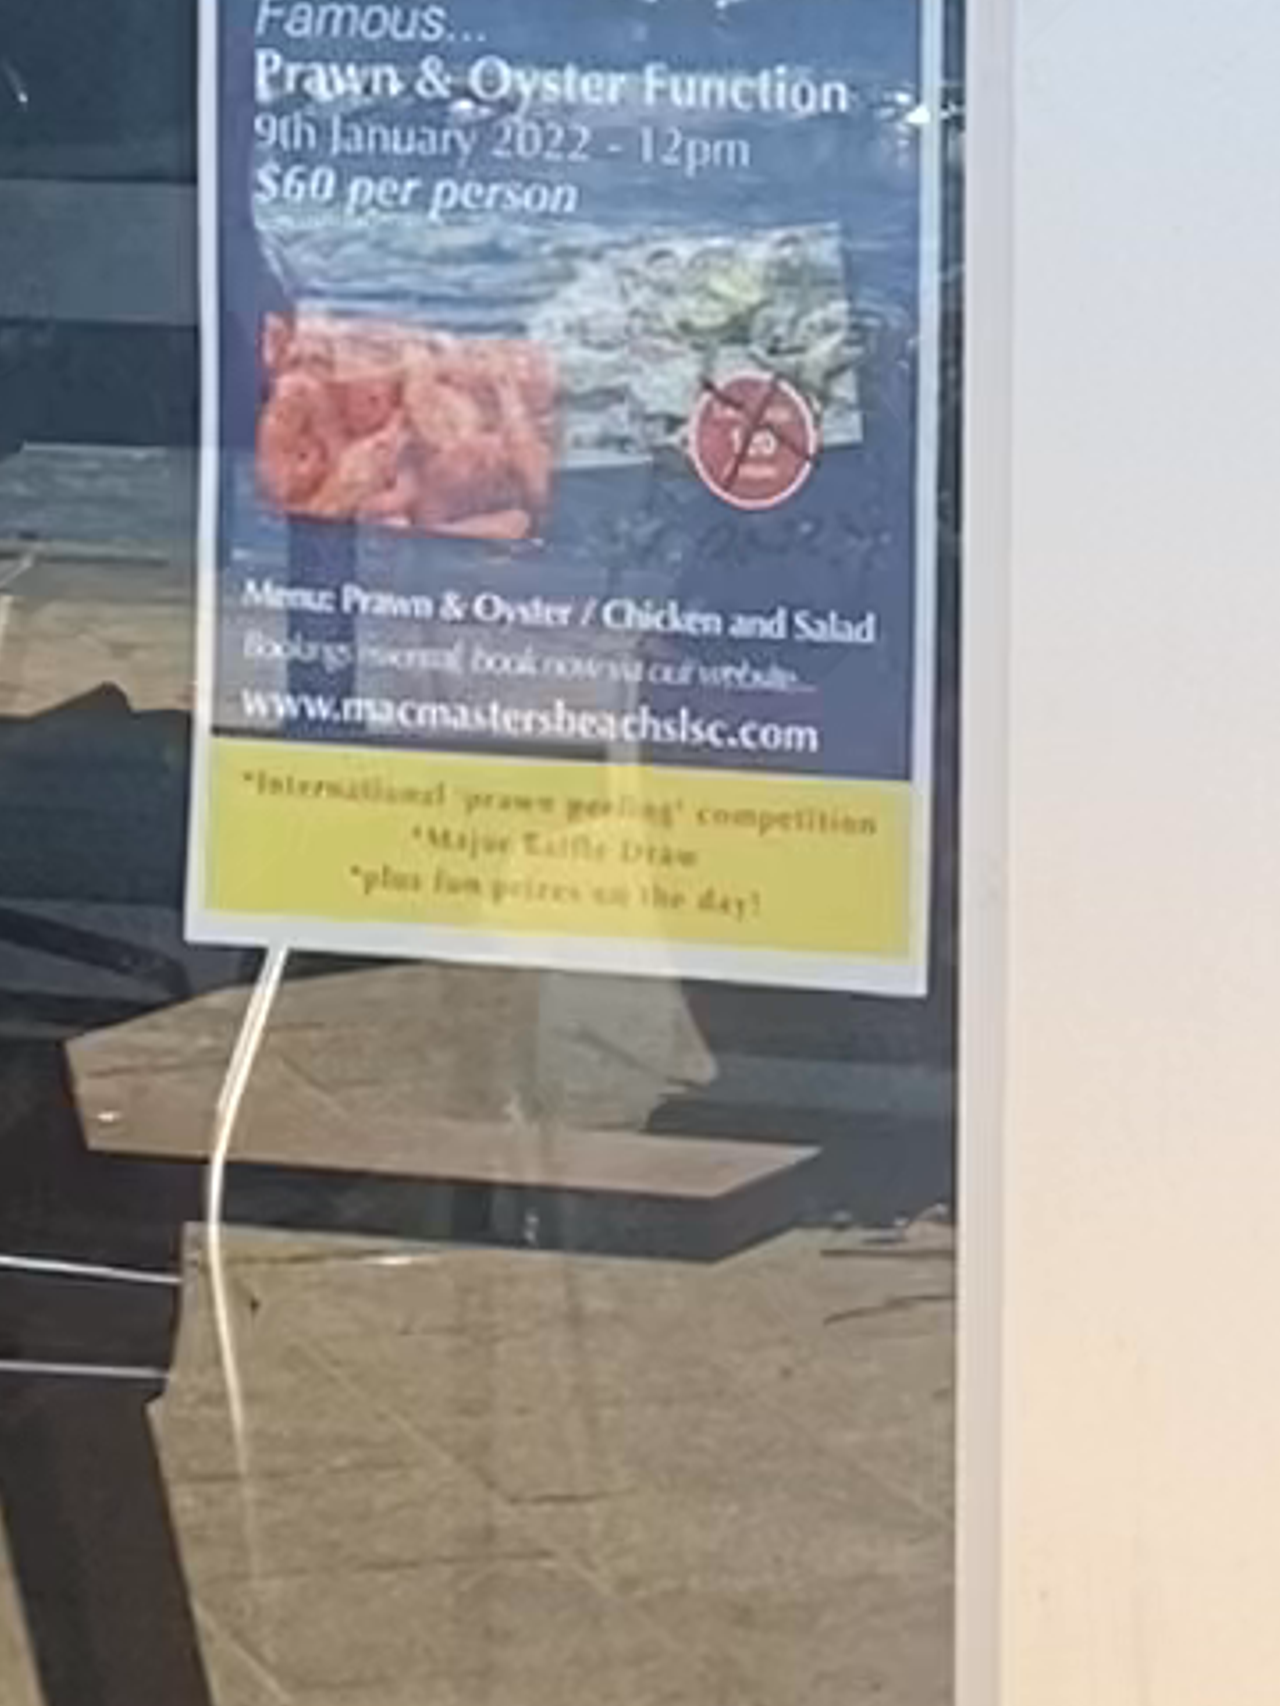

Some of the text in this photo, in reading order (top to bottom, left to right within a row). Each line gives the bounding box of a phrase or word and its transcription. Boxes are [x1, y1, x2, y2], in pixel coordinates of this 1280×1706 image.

[253, 47, 849, 117] Prawn & Oyster Function
[253, 112, 317, 151] 9th
[331, 113, 477, 168] January
[491, 120, 591, 163] 2022
[640, 126, 751, 178] 12pm
[253, 159, 579, 221] $60 per person
[340, 583, 433, 619] Prawn
[439, 590, 467, 622] &
[473, 592, 572, 629] Oyster
[601, 597, 721, 635] Chicken
[727, 606, 788, 640] and
[793, 609, 877, 644] Salad
[242, 689, 819, 753] www.macmastersbeachslsc.com
[696, 805, 878, 837] competition
